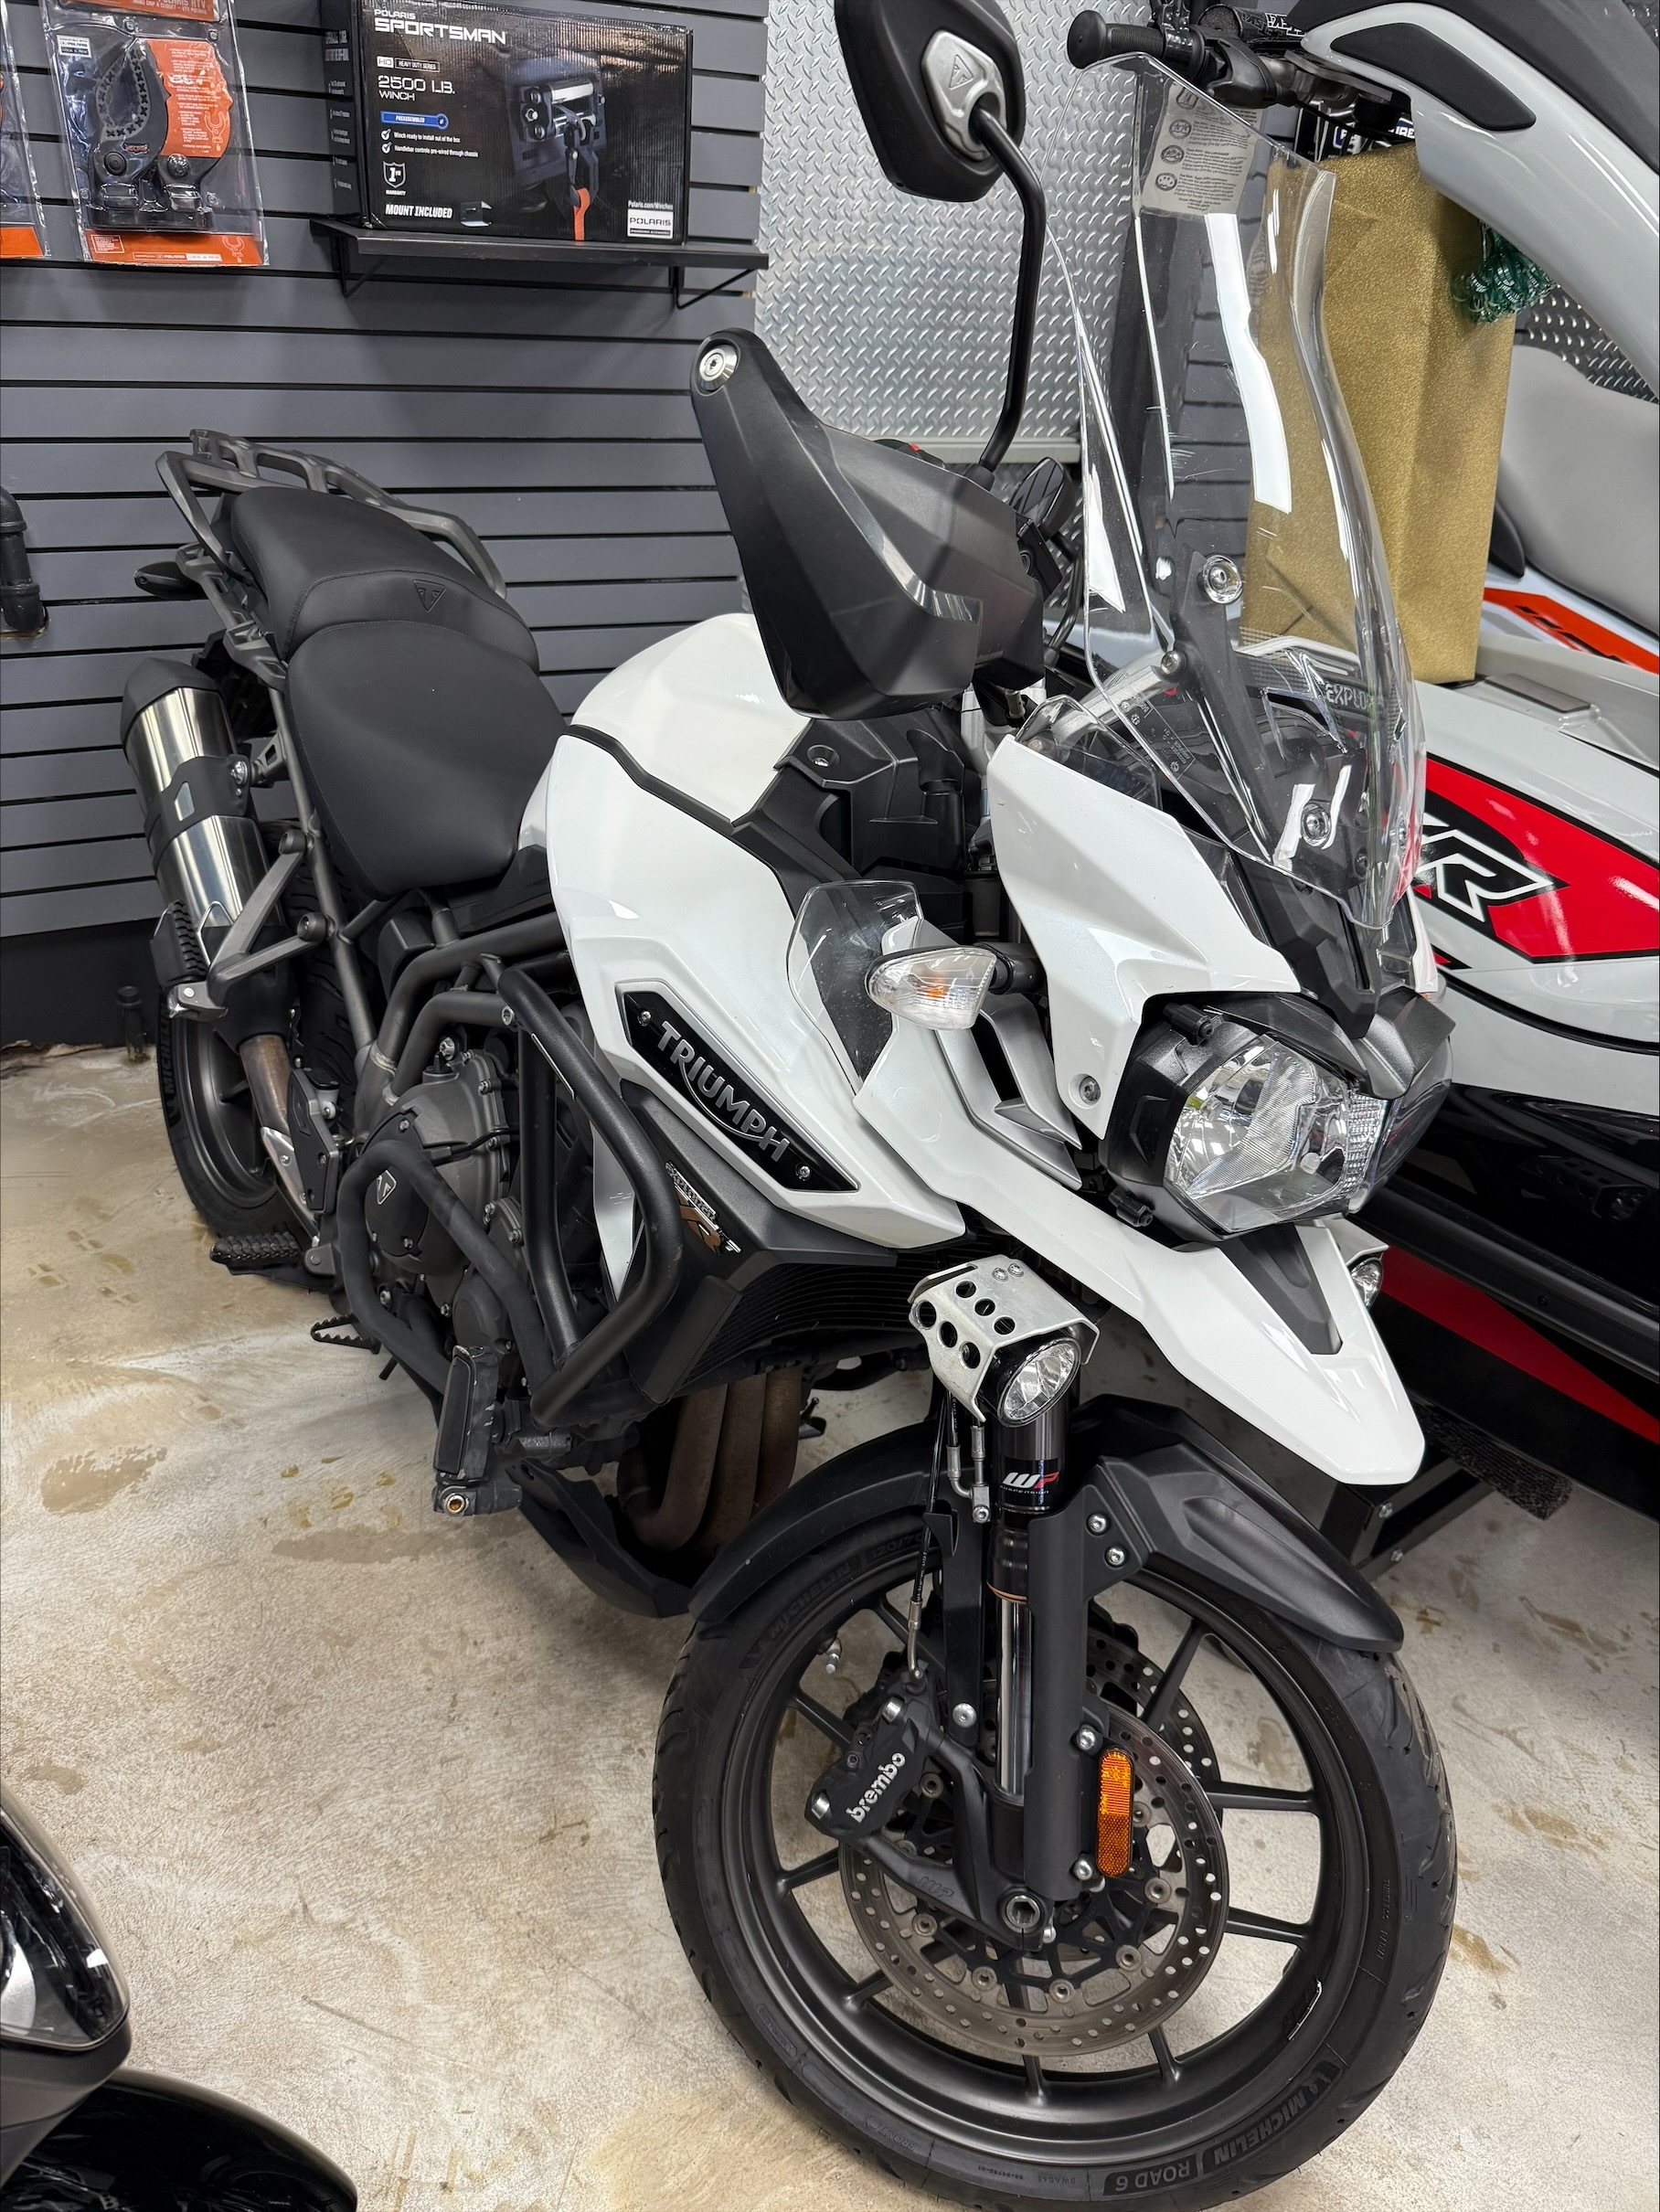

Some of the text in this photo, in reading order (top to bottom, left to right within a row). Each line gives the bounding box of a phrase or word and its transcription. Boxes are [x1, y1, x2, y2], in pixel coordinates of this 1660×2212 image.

[374, 8, 416, 20] POLARIS
[374, 17, 506, 45] SPORTSMAN
[422, 62, 437, 70] SERIES
[378, 75, 455, 95] 2500 LB.
[378, 90, 415, 101] WINCH
[407, 133, 418, 141] ready
[385, 204, 452, 218] MOUNT INCLUDED
[630, 217, 671, 226] POLARIS
[656, 1020, 791, 1163] TRIUMPH
[1002, 1471, 1060, 1490] WP
[846, 1752, 906, 1824] brembo
[1115, 2089, 1307, 2193] MICHELIN ROAD 6
